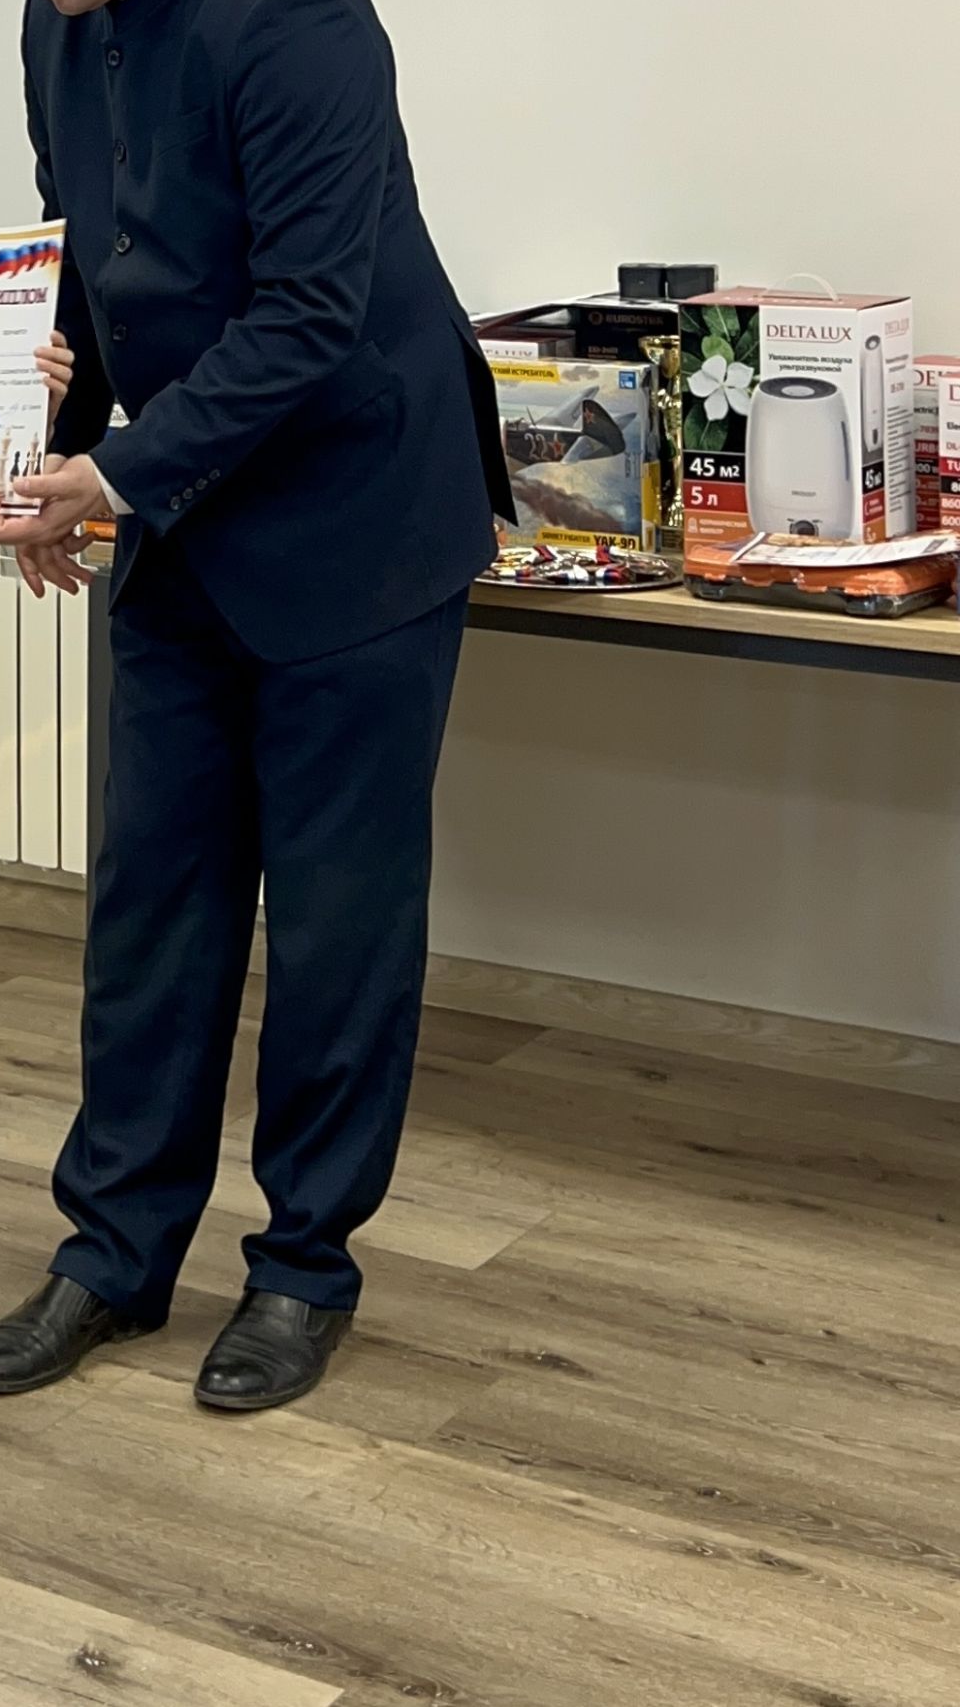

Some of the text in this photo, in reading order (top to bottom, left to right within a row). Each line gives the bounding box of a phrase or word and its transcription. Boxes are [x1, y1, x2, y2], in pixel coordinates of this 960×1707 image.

[766, 324, 852, 340] DELTA LUX
[689, 457, 715, 477] 45
[690, 485, 704, 505] 5
[593, 534, 636, 550] YAK-9D
